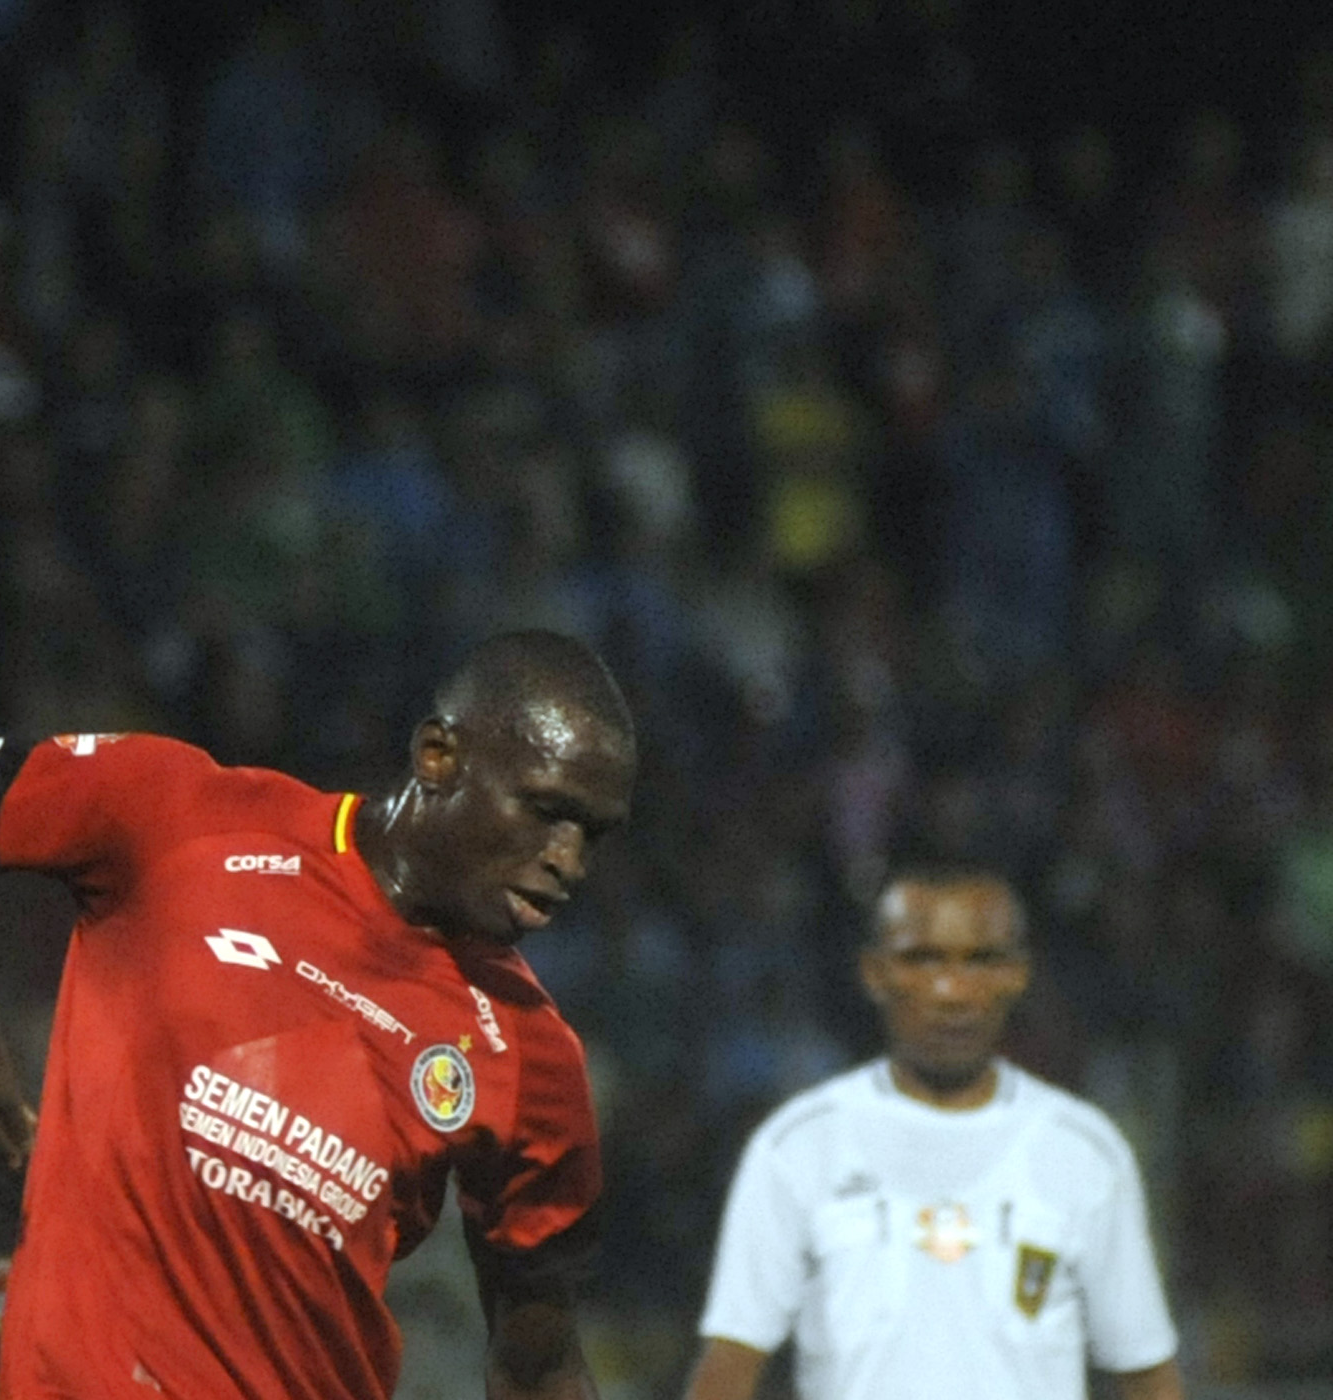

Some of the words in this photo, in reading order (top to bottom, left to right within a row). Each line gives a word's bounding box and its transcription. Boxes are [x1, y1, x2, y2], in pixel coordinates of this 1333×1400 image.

[184, 1064, 289, 1137] SEMEN
[285, 1115, 389, 1201] PADANG
[232, 1129, 322, 1196] INDONESIA
[319, 1179, 368, 1225] GROUP
